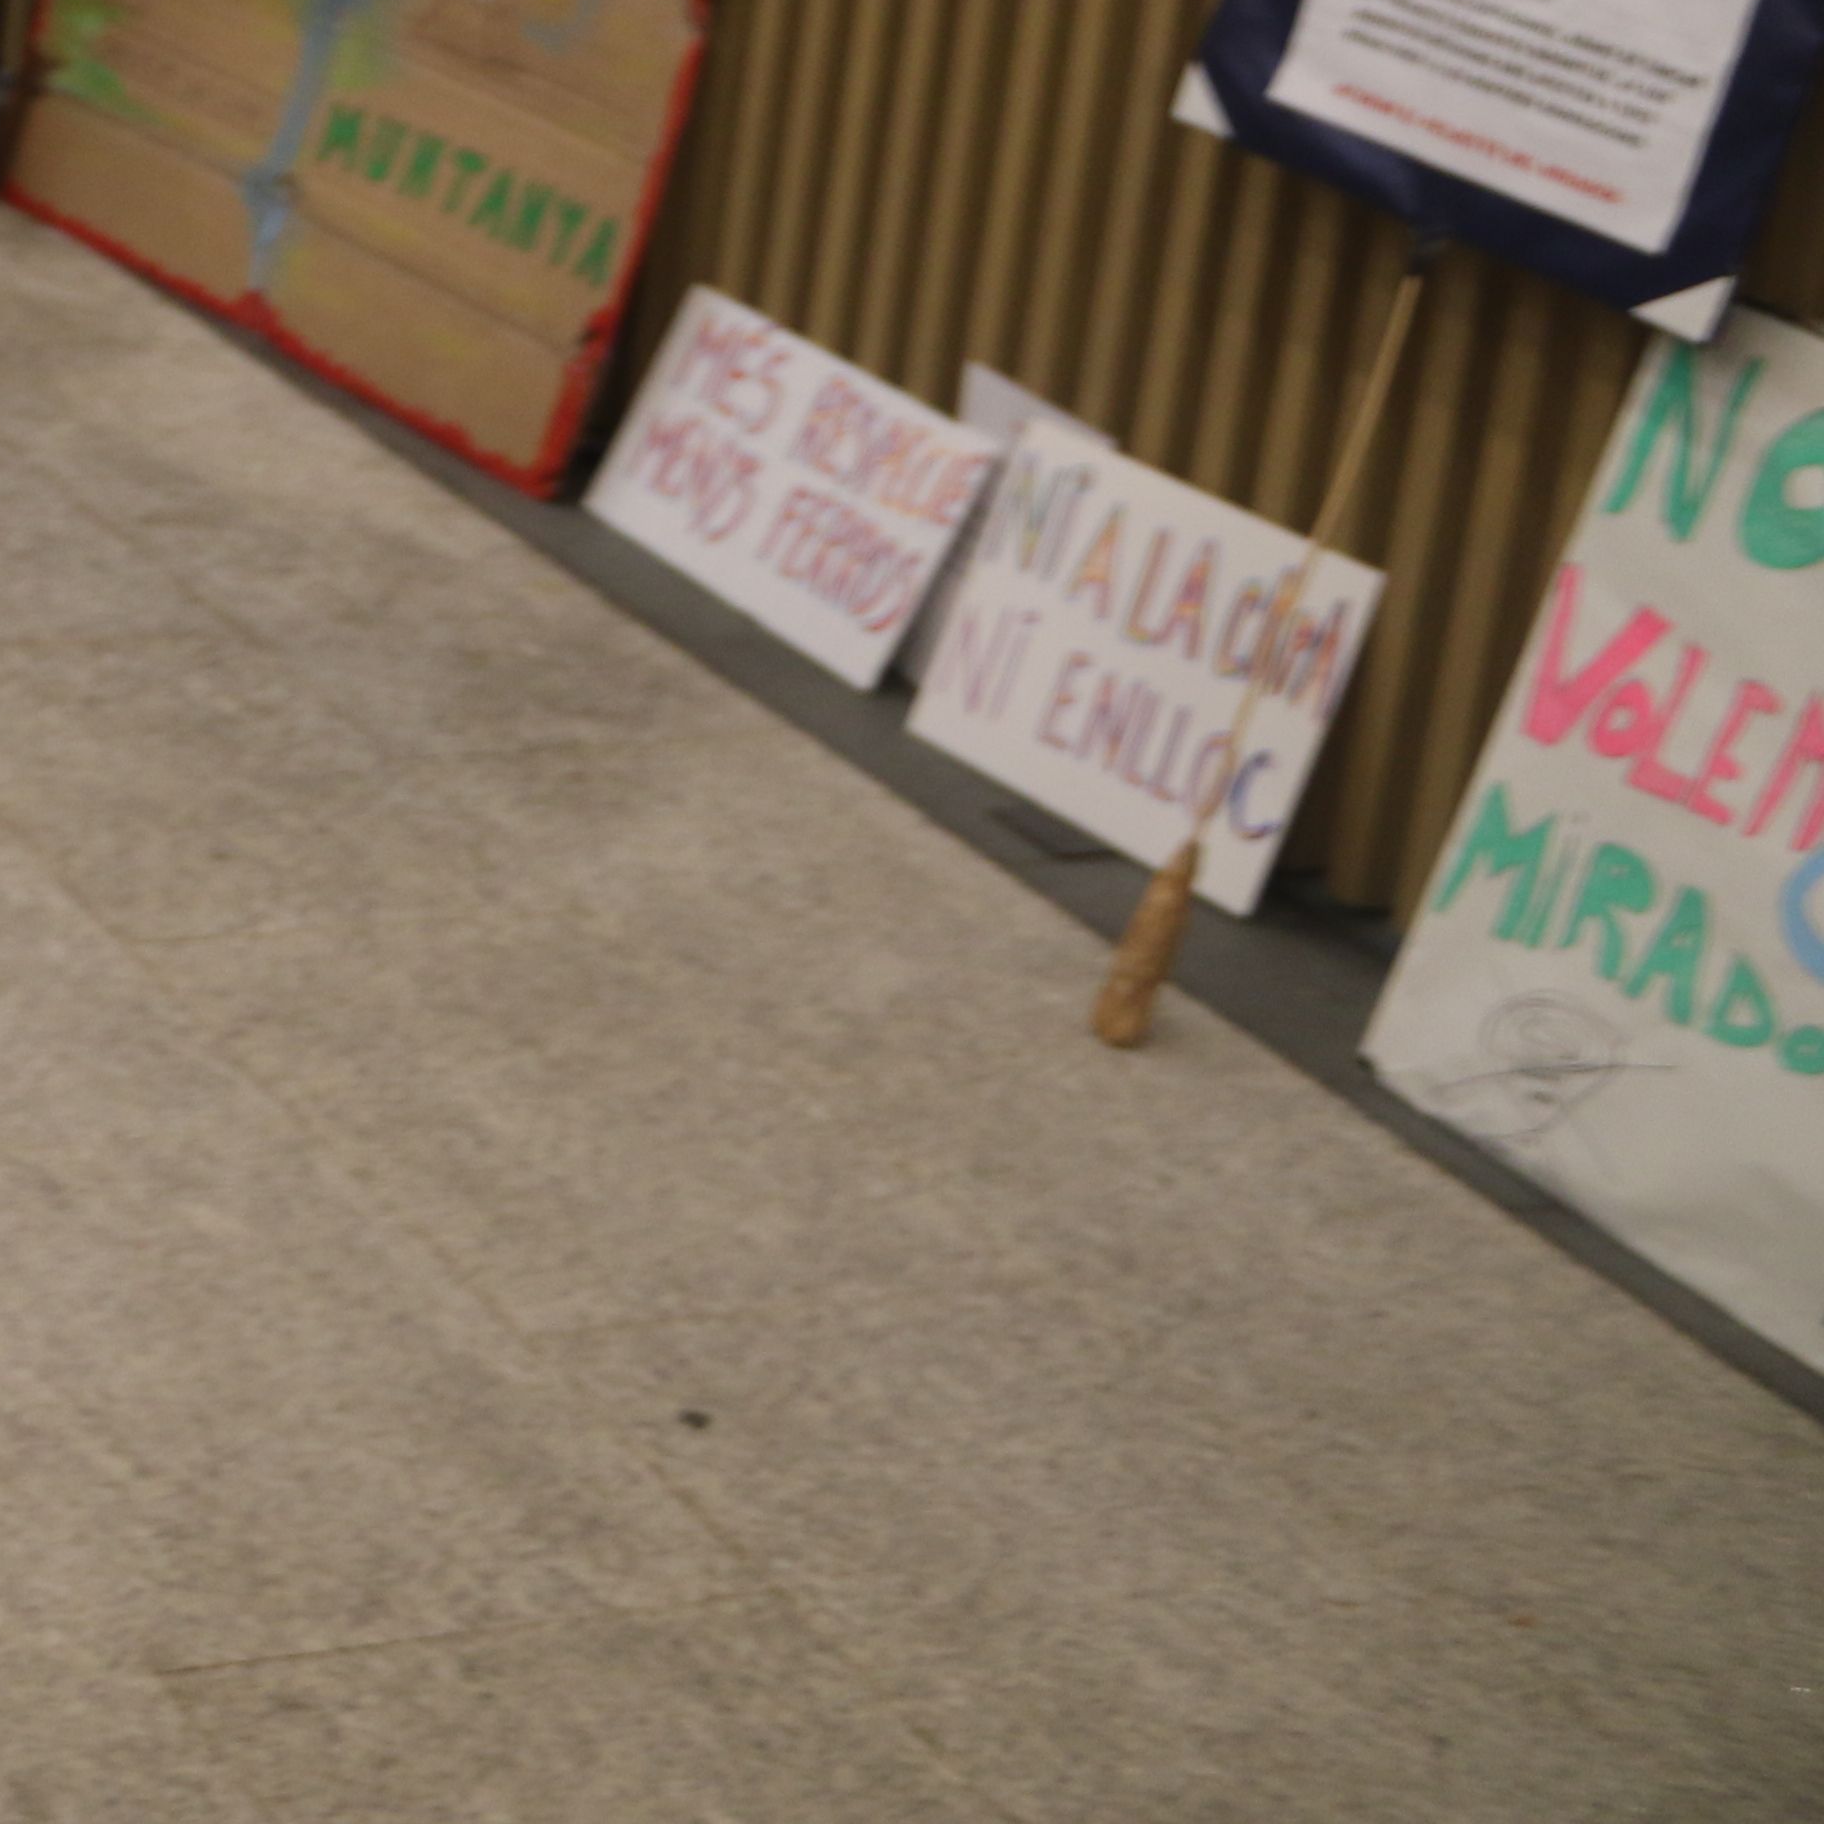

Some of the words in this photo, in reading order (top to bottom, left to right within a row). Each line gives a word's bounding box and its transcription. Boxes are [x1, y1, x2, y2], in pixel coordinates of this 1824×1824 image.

[1604, 344, 1824, 569] NO
[1066, 505, 1130, 622] A
[1123, 528, 1224, 663] LA
